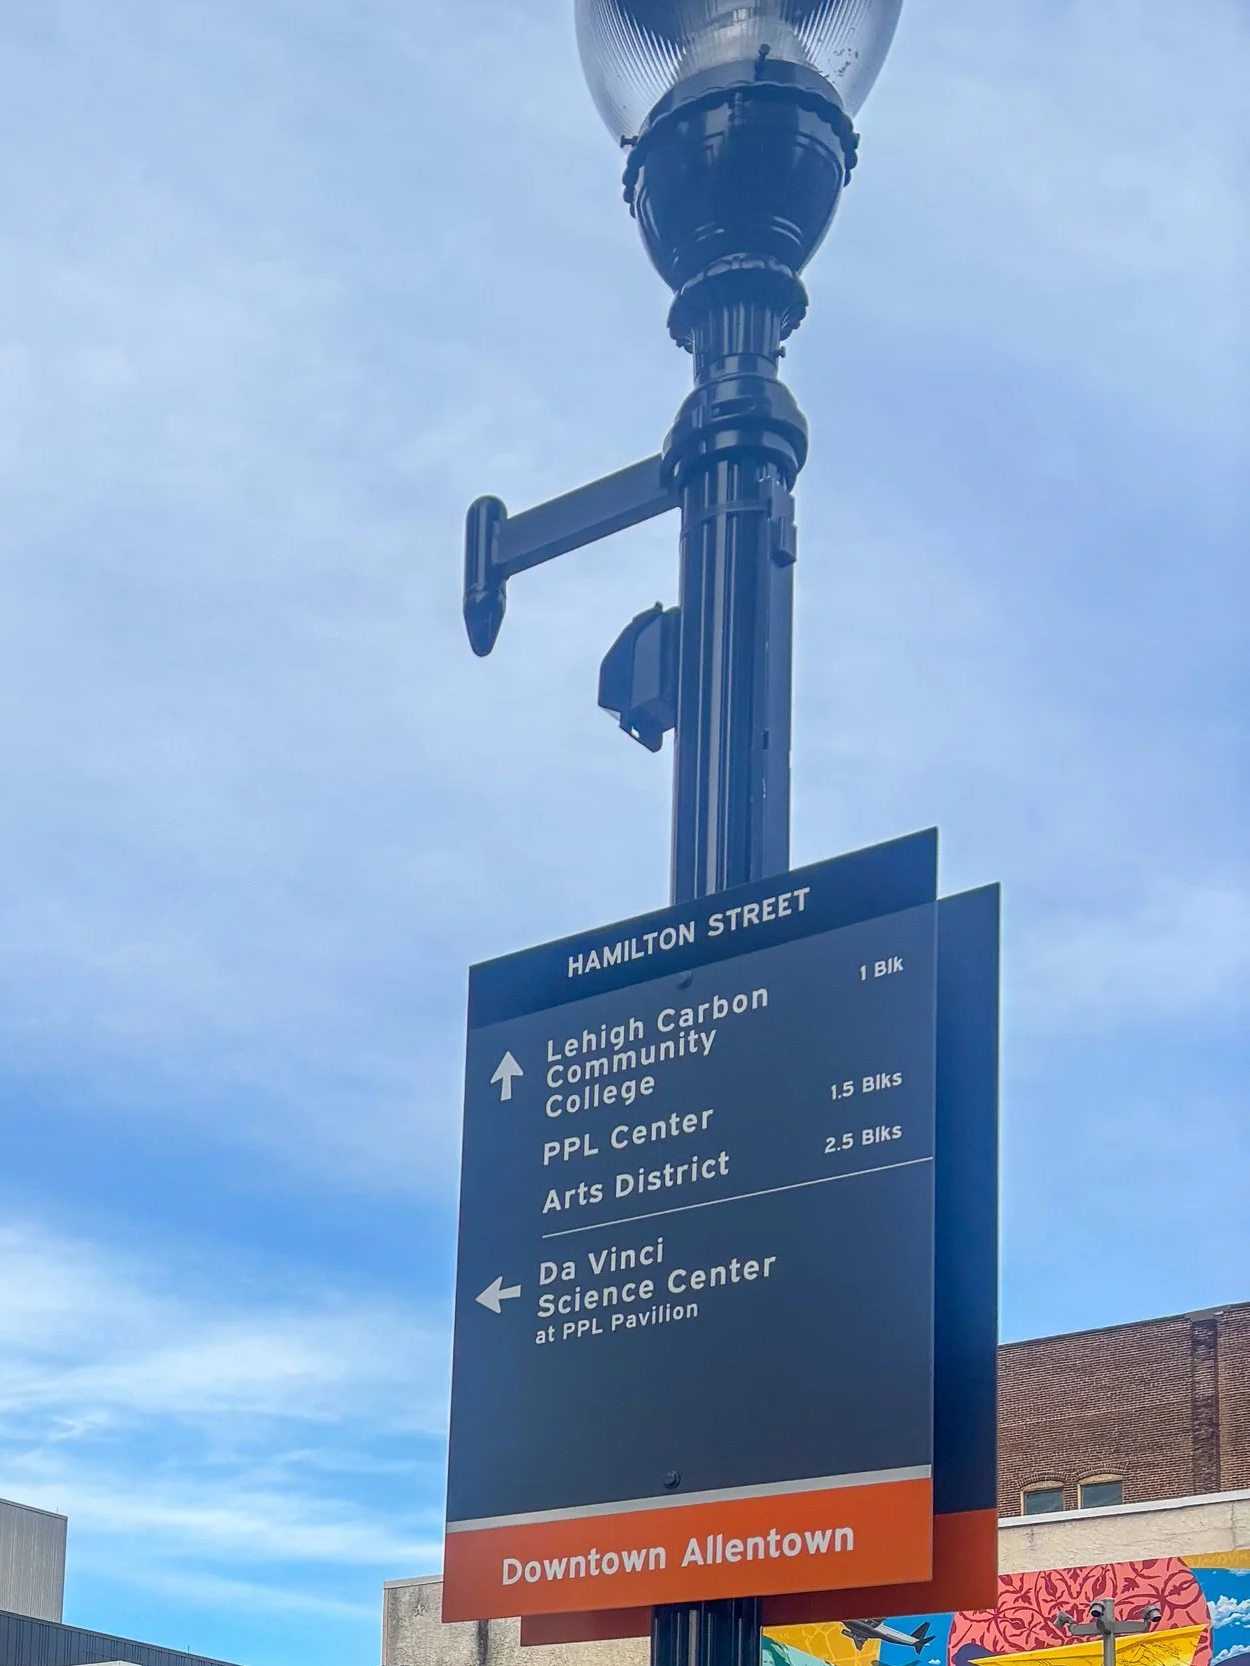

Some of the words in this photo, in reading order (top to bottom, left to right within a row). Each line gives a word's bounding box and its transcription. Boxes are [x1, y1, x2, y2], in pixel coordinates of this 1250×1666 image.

[567, 921, 696, 978] HAMILTON
[707, 886, 811, 937] STREET
[859, 965, 867, 980] 1
[873, 956, 904, 977] Blk
[546, 1018, 645, 1063] Lehigh
[656, 987, 770, 1033] Carbon
[545, 1028, 718, 1088] Community
[830, 1082, 855, 1100] 1.5
[862, 1071, 903, 1094] Blks
[545, 1076, 656, 1119] College
[543, 1134, 599, 1166] PPL
[610, 1108, 714, 1148] Center
[824, 1134, 854, 1154] 2.5
[862, 1124, 903, 1146] Blks
[542, 1180, 603, 1214] Arts
[615, 1151, 731, 1197] District
[537, 1276, 655, 1318] Science
[667, 1256, 777, 1295] Center
[539, 1259, 577, 1286] Da
[588, 1237, 665, 1276] Vinci
[535, 1326, 555, 1345] at
[562, 1319, 603, 1340] PPL
[610, 1301, 699, 1332] Pavilion
[502, 1543, 667, 1587] Downtown
[681, 1525, 855, 1567] Allentown
